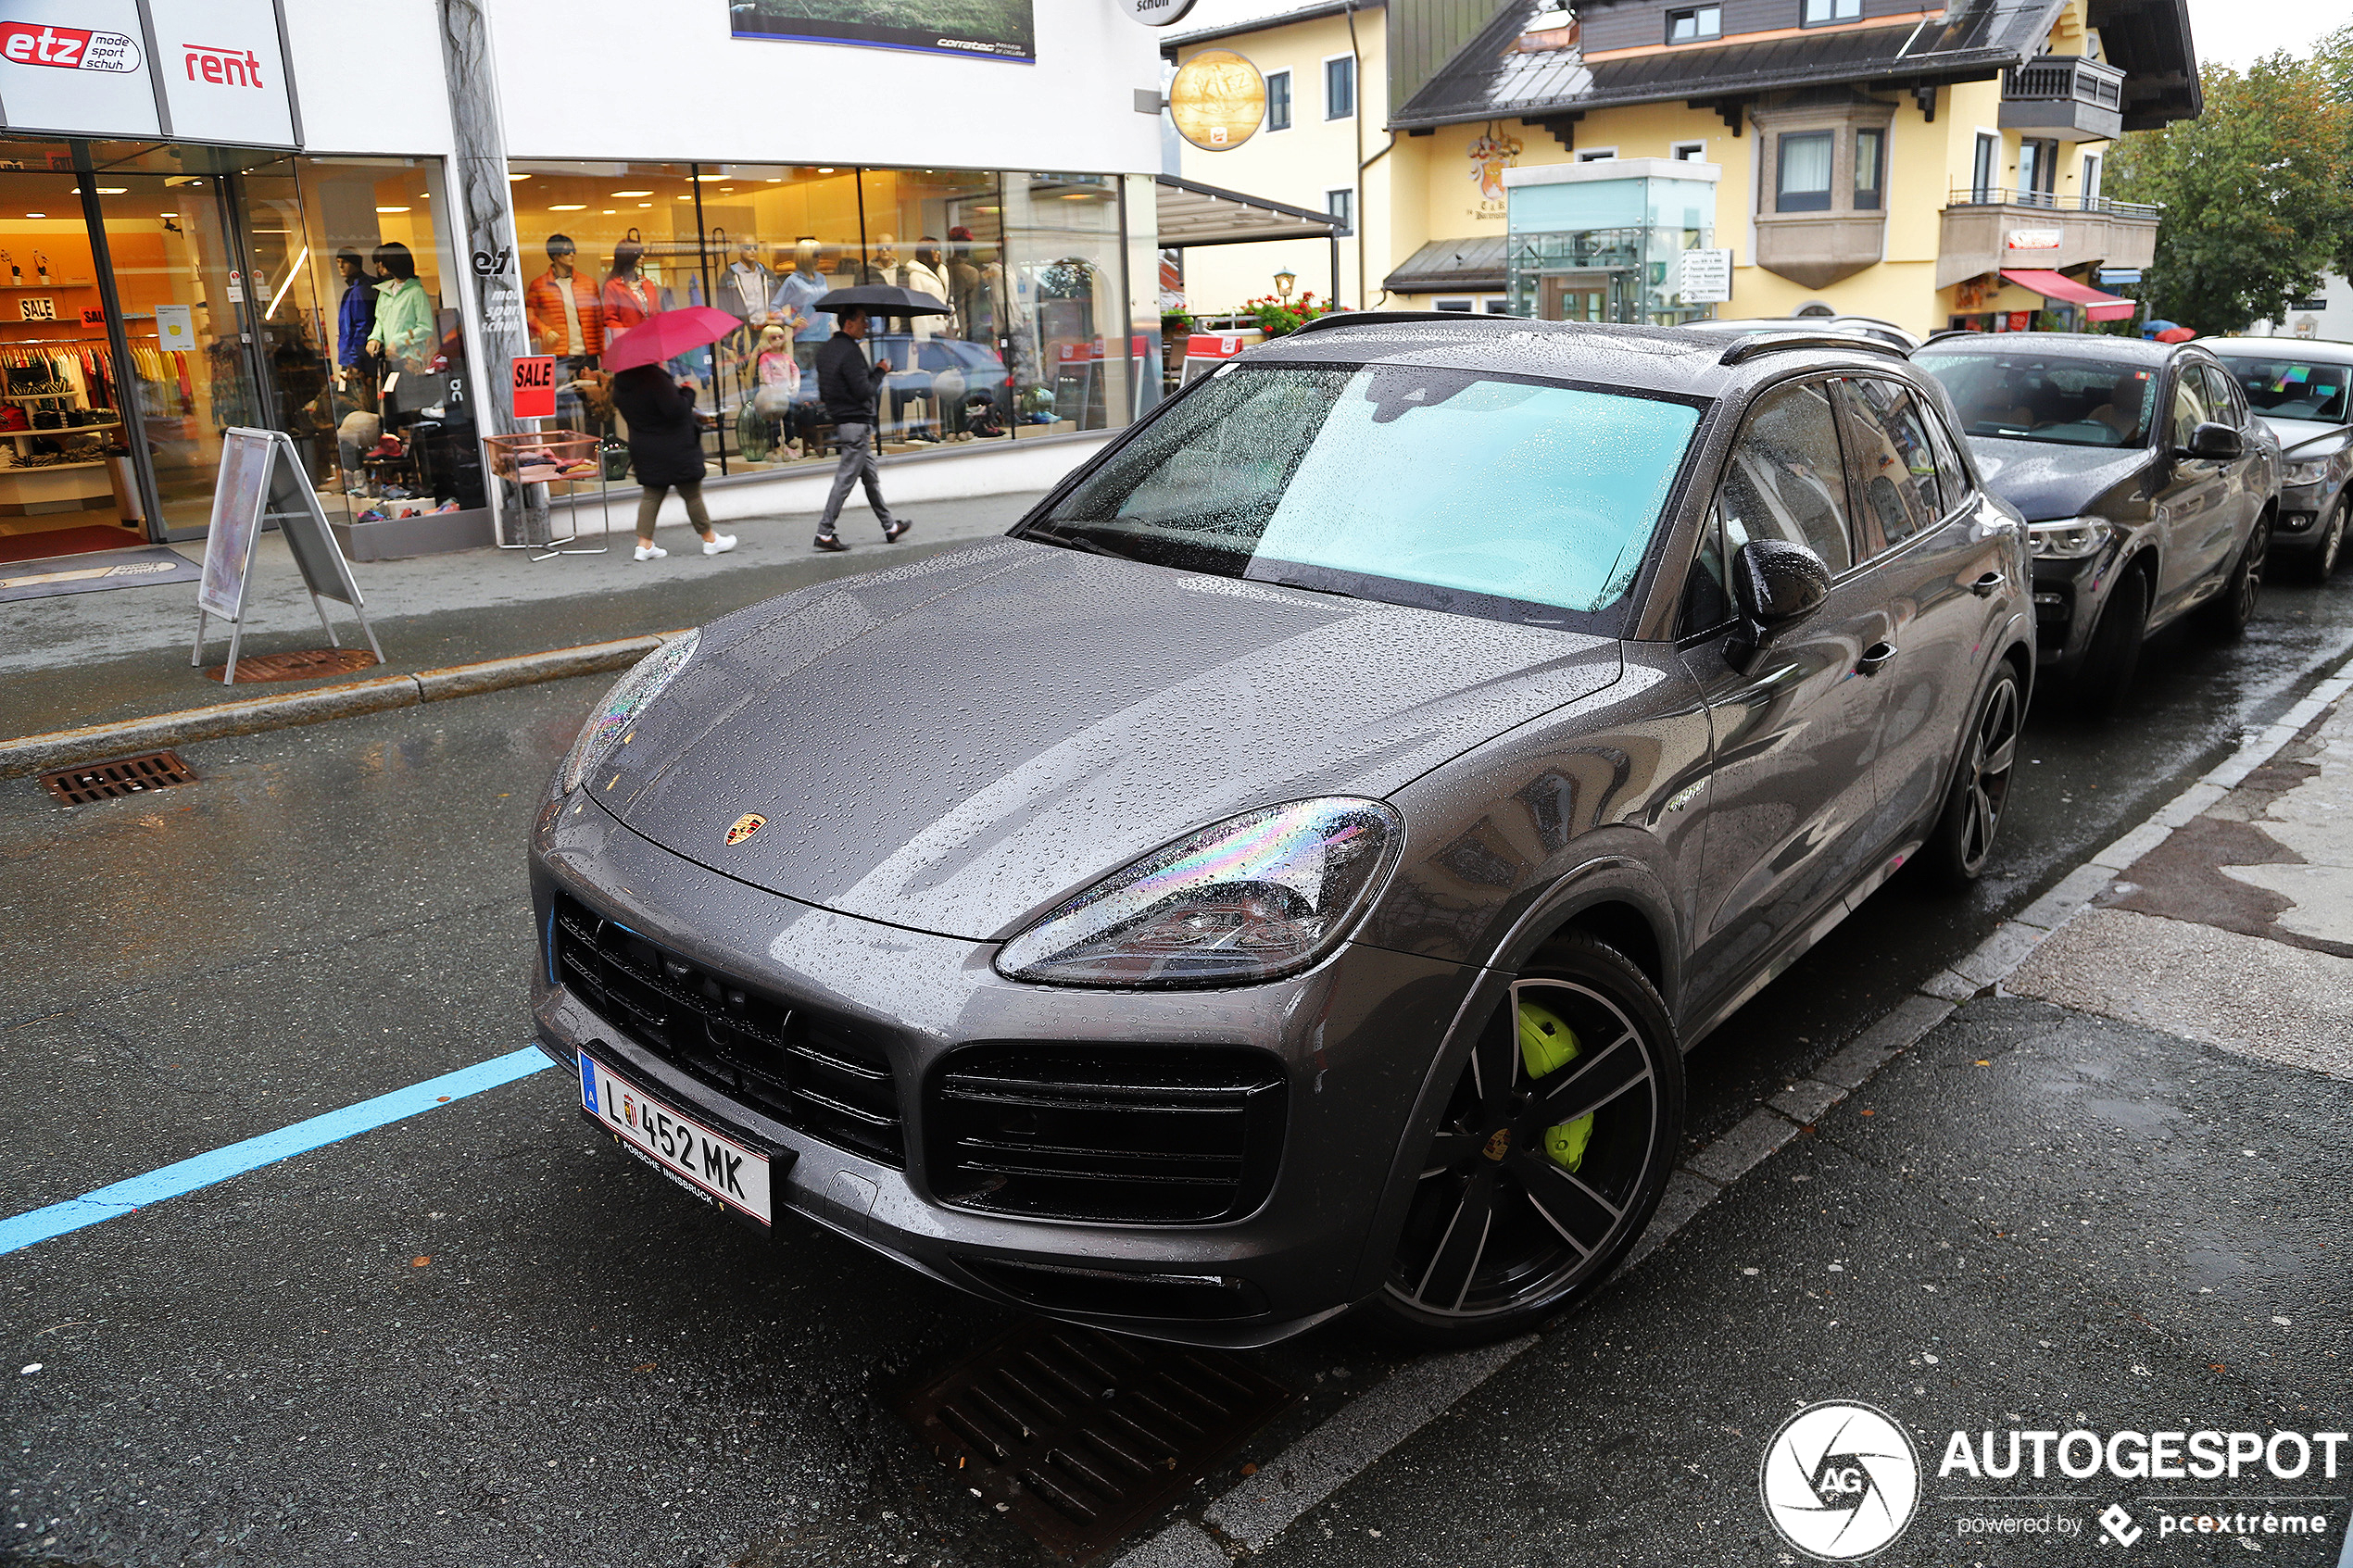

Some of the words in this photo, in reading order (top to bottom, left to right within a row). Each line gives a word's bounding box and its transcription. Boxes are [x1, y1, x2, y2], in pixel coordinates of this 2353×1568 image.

[5, 28, 82, 65] etz
[95, 35, 130, 46] mode
[937, 38, 996, 52] corratec
[92, 47, 125, 58] sport
[86, 58, 123, 70] schuh
[184, 49, 263, 89] rent
[472, 245, 515, 275] et
[21, 299, 53, 318] SALE
[83, 310, 106, 323] SAL
[485, 305, 520, 321] spor
[515, 363, 551, 387] SALE
[587, 1090, 596, 1105] A
[606, 1079, 623, 1124] L
[642, 1102, 697, 1172] 452
[701, 1136, 746, 1200] MK
[623, 1140, 661, 1173] PORSCHE
[662, 1167, 713, 1206] INNSBRUCK
